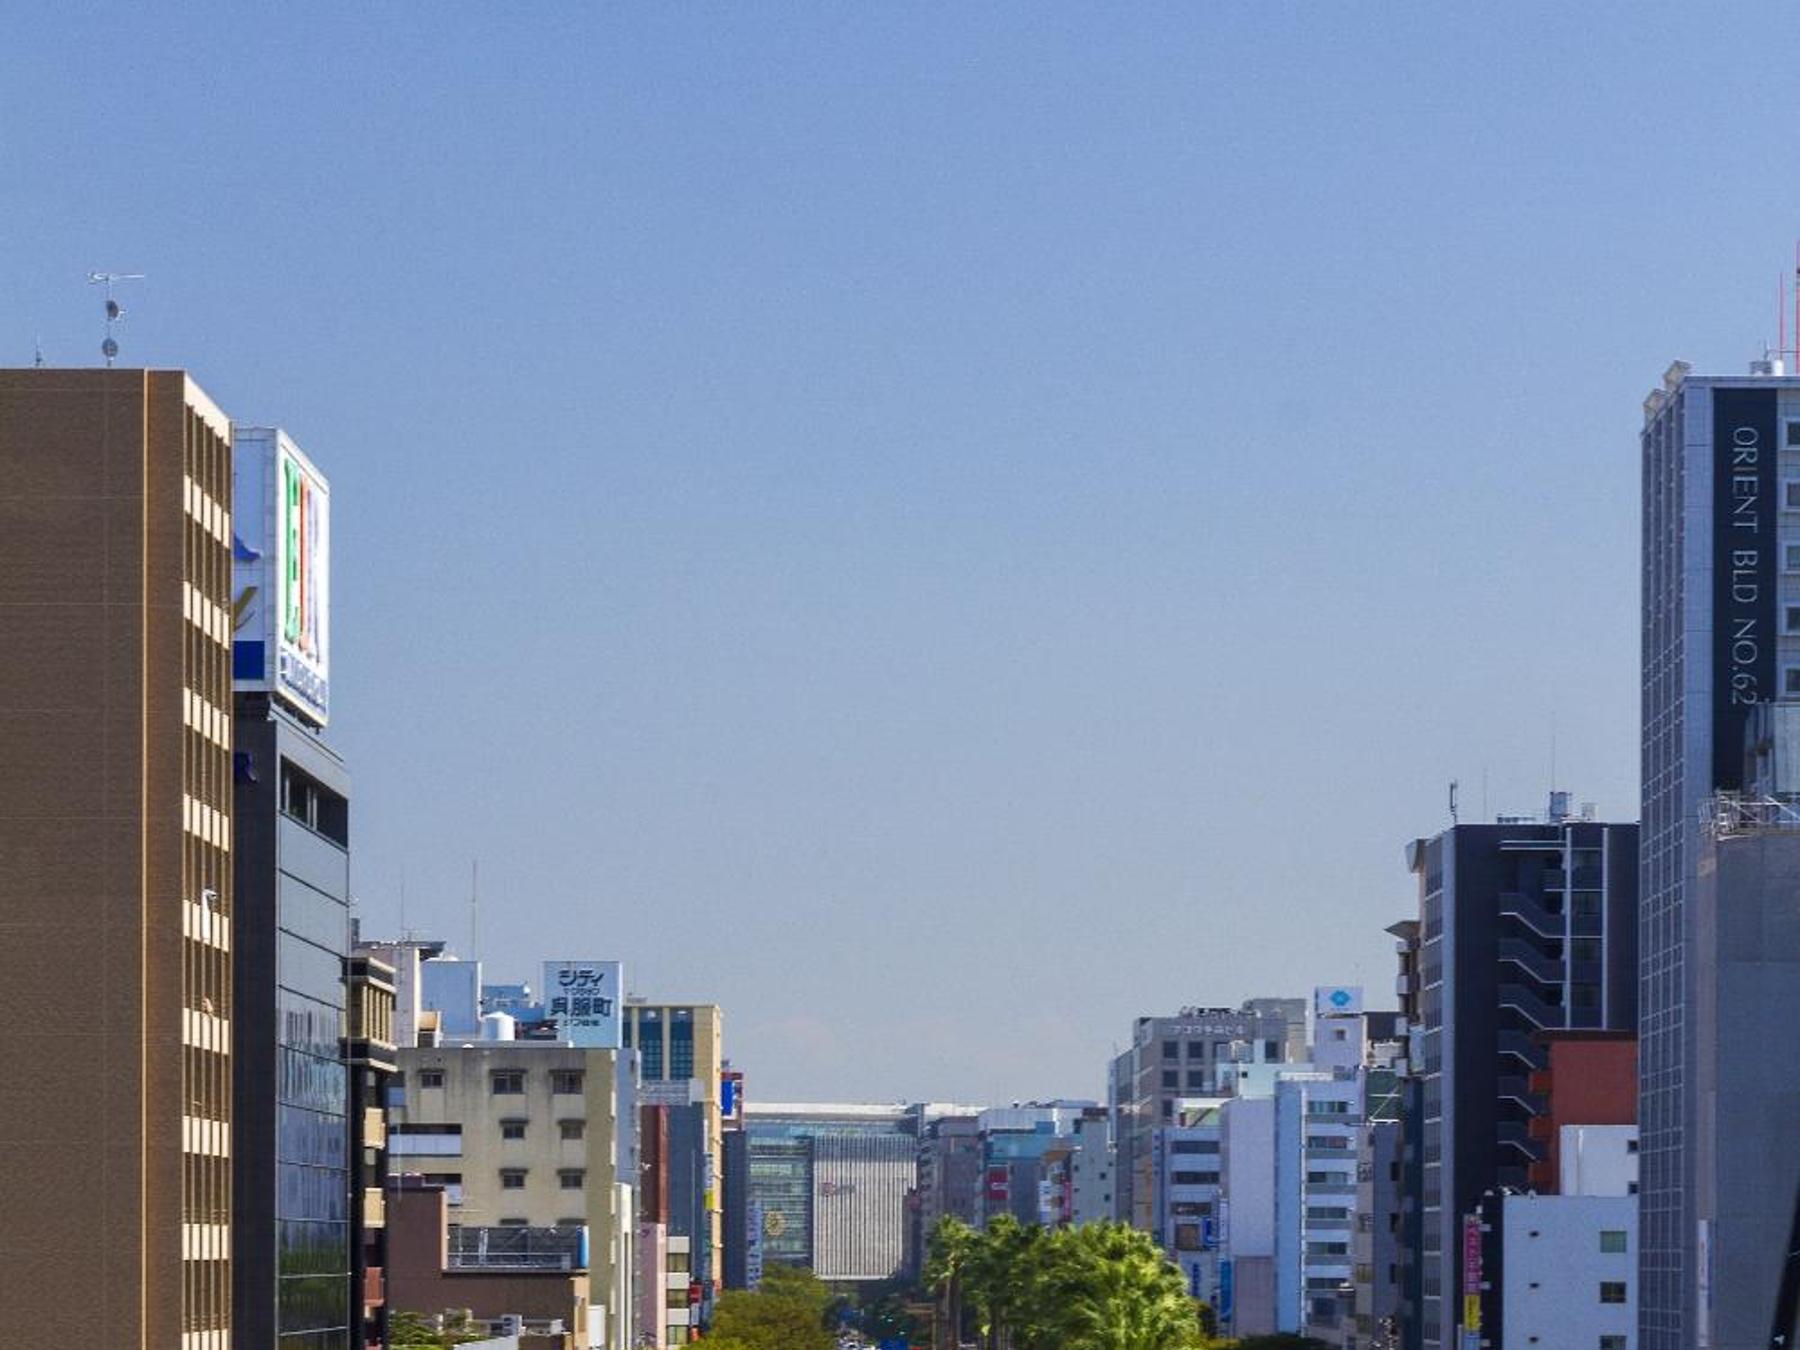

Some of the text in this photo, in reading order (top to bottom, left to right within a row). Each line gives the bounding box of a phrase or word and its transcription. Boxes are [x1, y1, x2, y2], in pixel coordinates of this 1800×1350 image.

[1731, 426, 1758, 705] ORIENT BLD NO.62
[558, 969, 604, 986] シティ
[550, 997, 612, 1017] 呉服町
